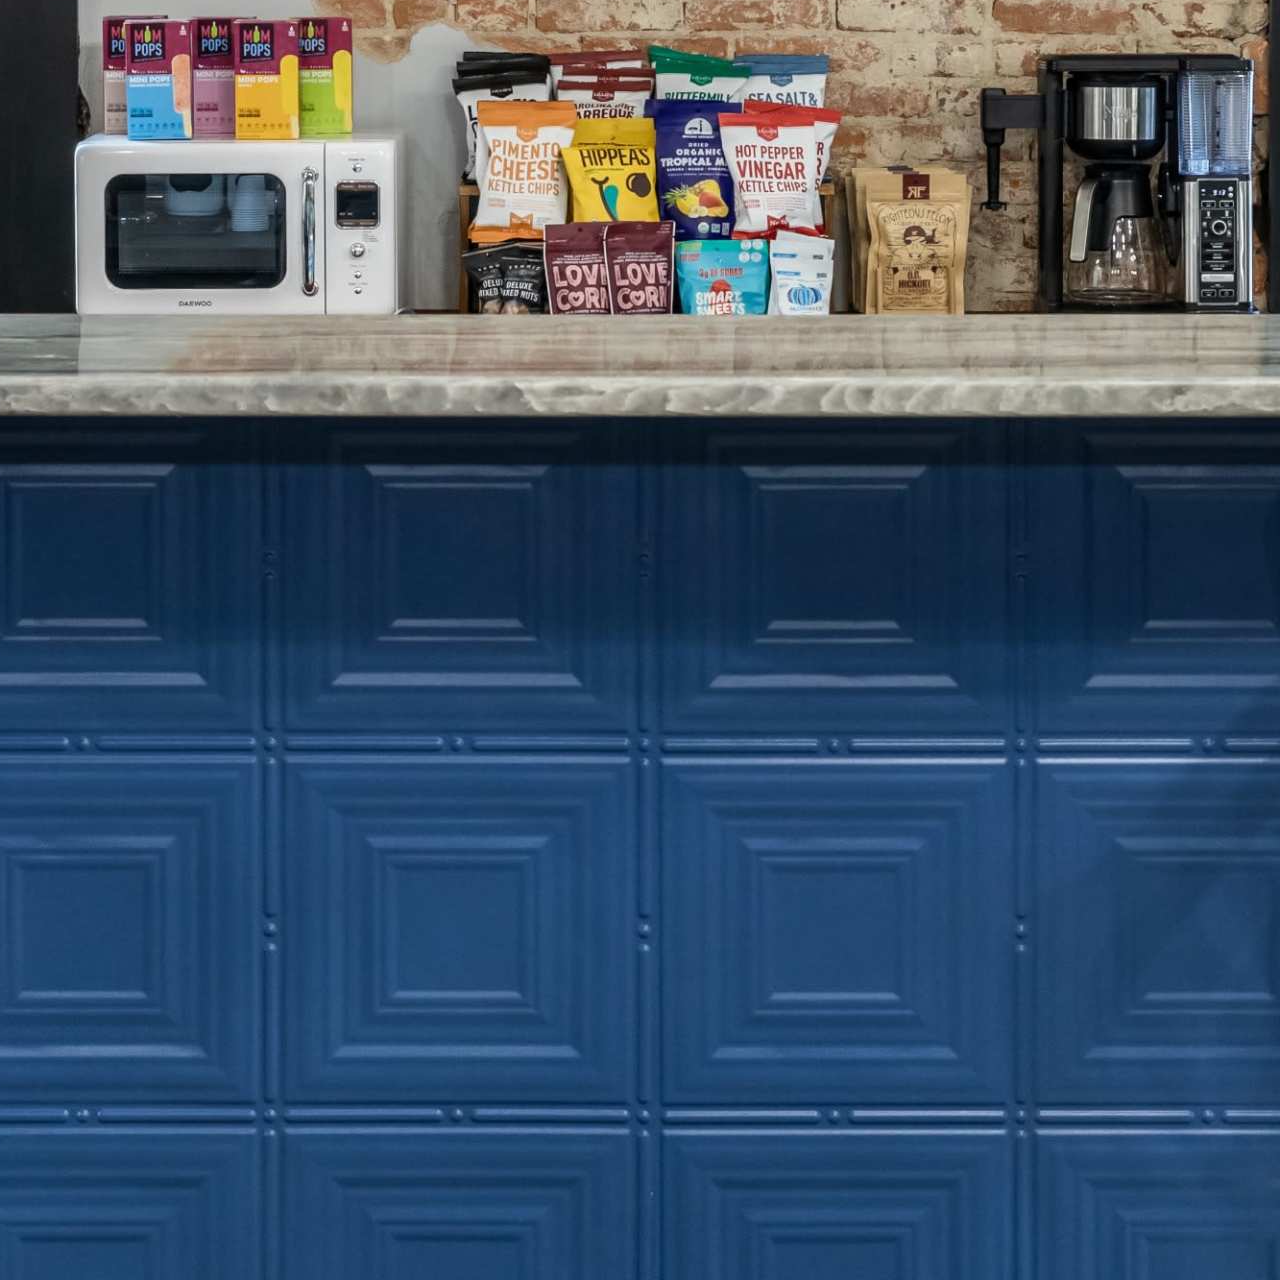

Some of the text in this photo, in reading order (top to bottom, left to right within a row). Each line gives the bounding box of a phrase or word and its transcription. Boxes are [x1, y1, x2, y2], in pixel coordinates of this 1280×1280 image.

[134, 43, 162, 57] POPS
[201, 38, 229, 52] POPS
[243, 43, 271, 57] POPS
[749, 93, 773, 105] SEA
[492, 139, 561, 159] PIMENTO
[676, 148, 722, 156] ORGANIC
[736, 144, 804, 160] HOT PEPPER
[579, 148, 651, 168] HIPPEAS
[660, 157, 712, 167] TROPICAL
[490, 156, 560, 181] CHEESE
[737, 160, 806, 179] VINEGAR
[488, 179, 560, 195] KETTLE CHIPS
[739, 180, 808, 193] KETTLE CHIPS
[506, 281, 533, 290] DELUXE
[520, 290, 540, 302] NUTS
